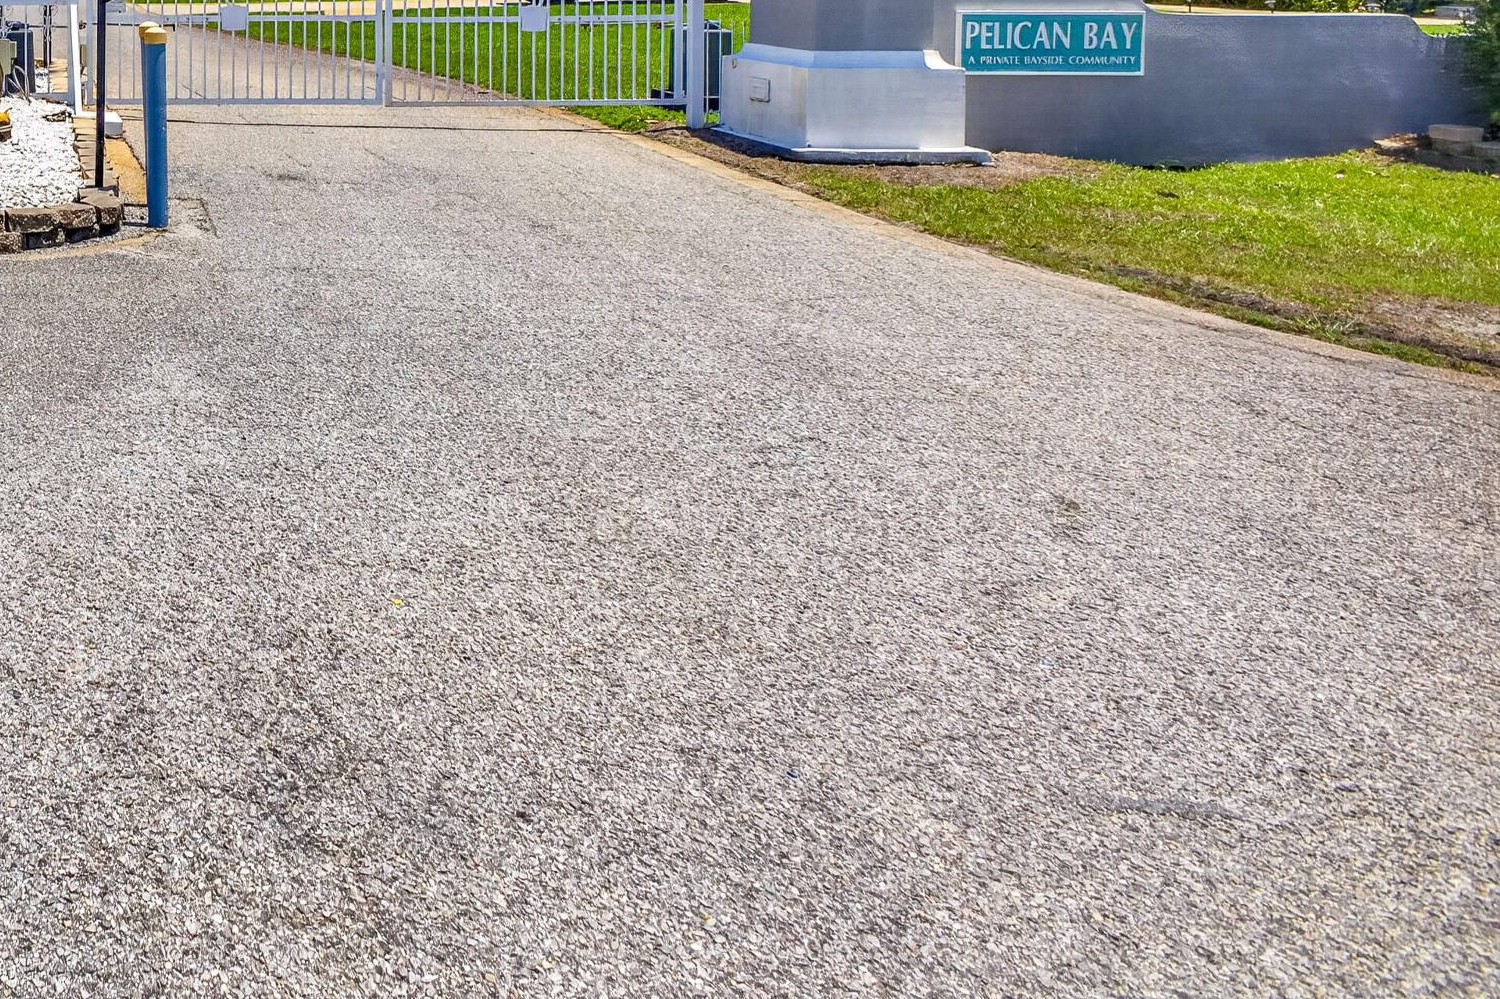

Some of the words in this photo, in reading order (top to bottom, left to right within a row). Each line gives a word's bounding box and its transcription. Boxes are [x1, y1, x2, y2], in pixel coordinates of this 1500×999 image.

[965, 21, 1071, 50] PELICAN
[1083, 21, 1137, 50] BAY
[968, 55, 976, 65] A
[980, 55, 1020, 65] PRIVATE
[1024, 55, 1064, 65] BAYSIDE
[1069, 55, 1136, 65] COMMUNITY
